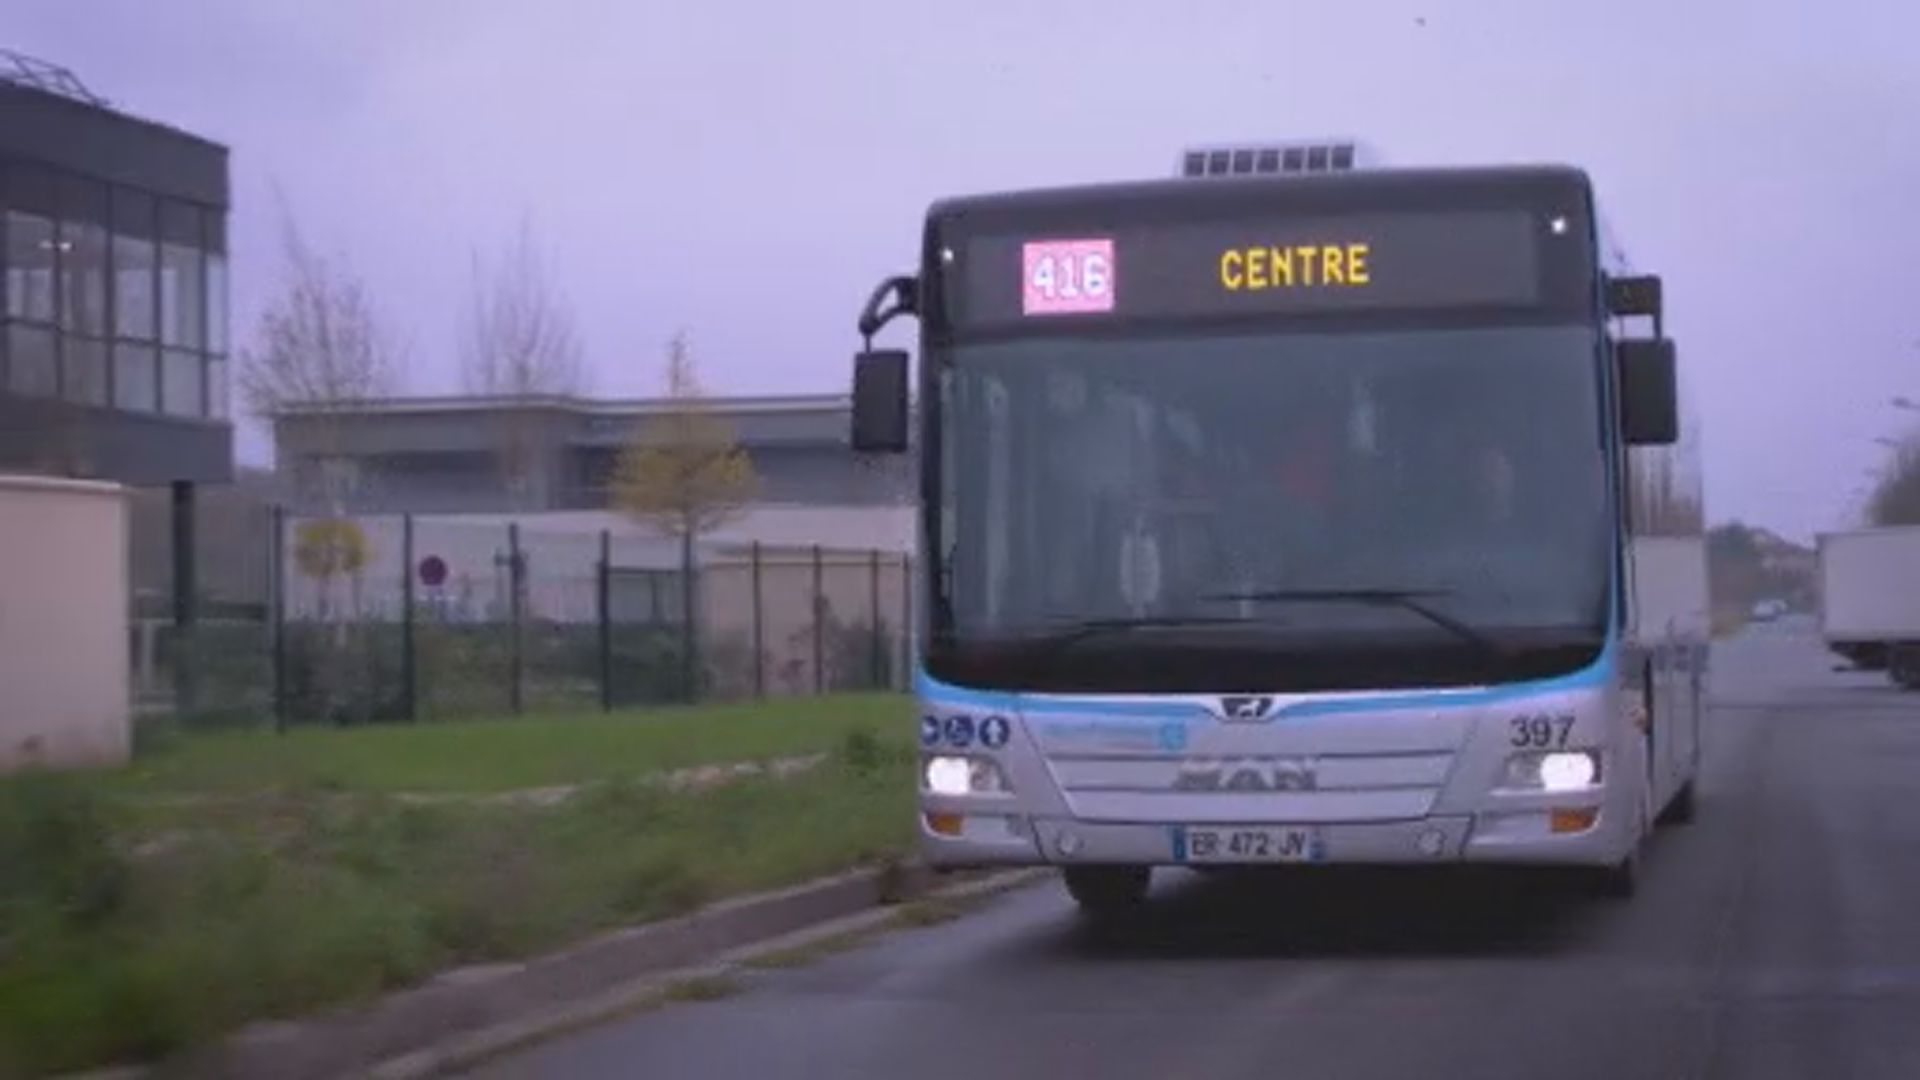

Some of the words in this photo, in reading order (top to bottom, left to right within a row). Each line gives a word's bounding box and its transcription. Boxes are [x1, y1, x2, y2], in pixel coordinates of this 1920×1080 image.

[1033, 253, 1106, 297] 416
[1220, 244, 1370, 290] CENTRE
[1509, 715, 1576, 750] 397
[1229, 831, 1269, 856] 472
